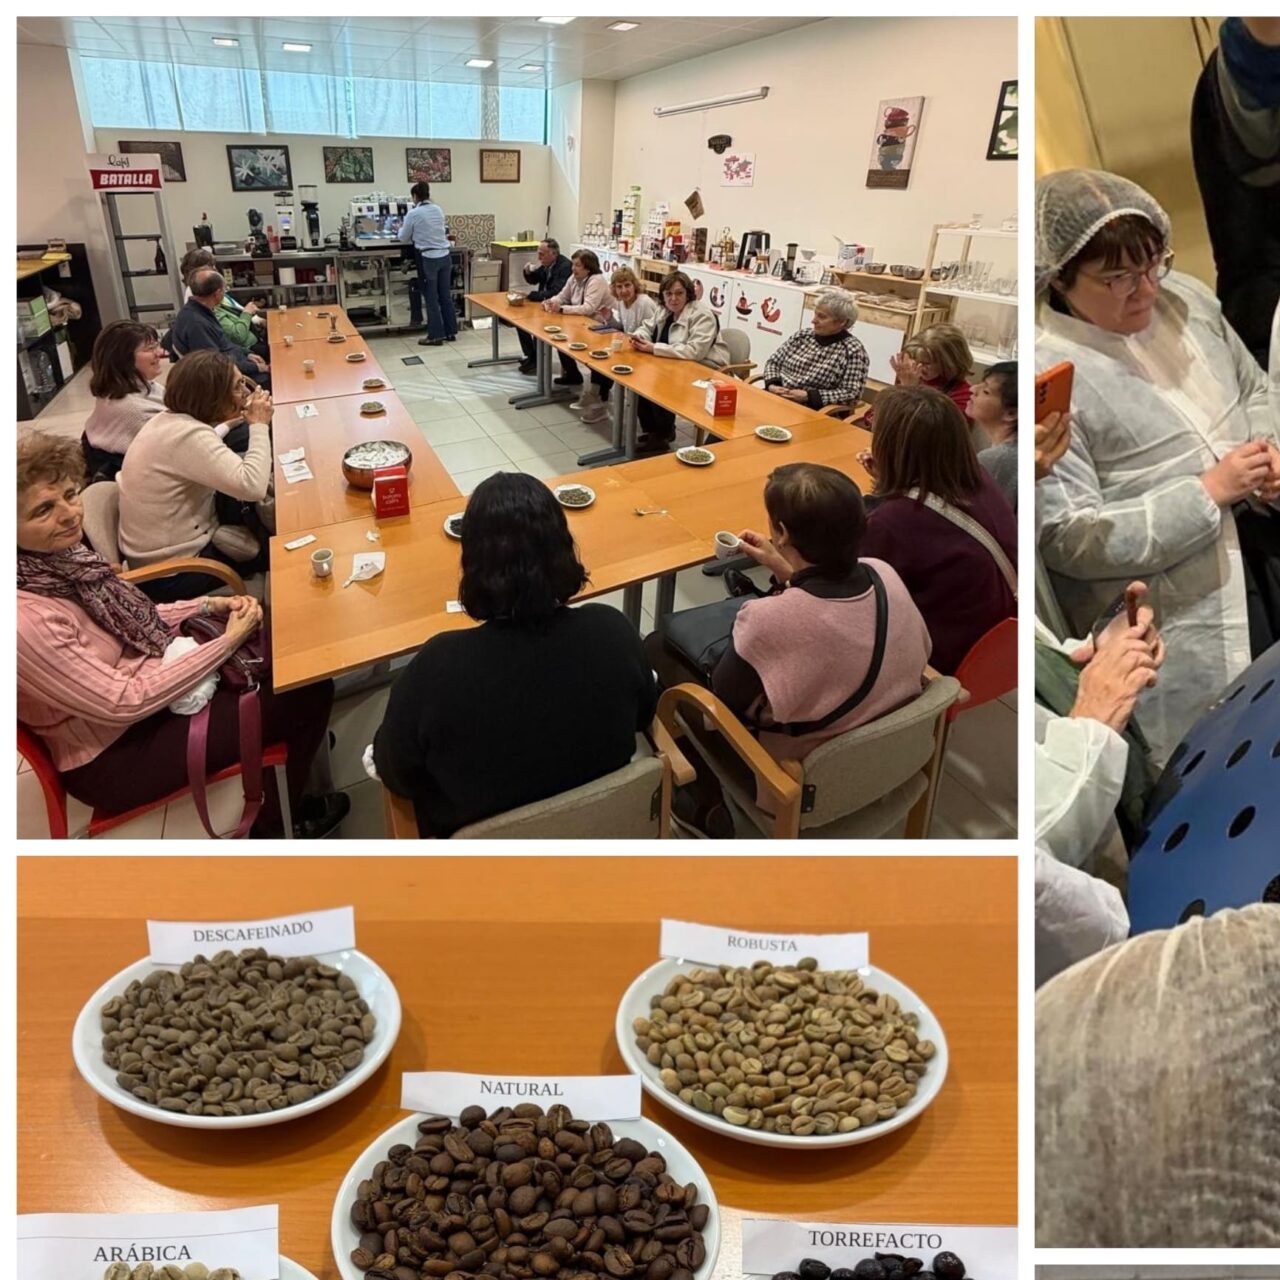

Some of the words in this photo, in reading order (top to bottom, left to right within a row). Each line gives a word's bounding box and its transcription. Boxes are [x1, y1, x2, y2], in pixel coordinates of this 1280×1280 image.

[100, 173, 153, 185] BATALLA
[193, 920, 314, 942] DESCAFEINADO
[727, 935, 798, 951] ROBUSTA
[480, 1080, 563, 1096] NATURAL
[808, 1230, 942, 1249] TORREFACTO
[94, 1243, 192, 1262] ARÁBICA
